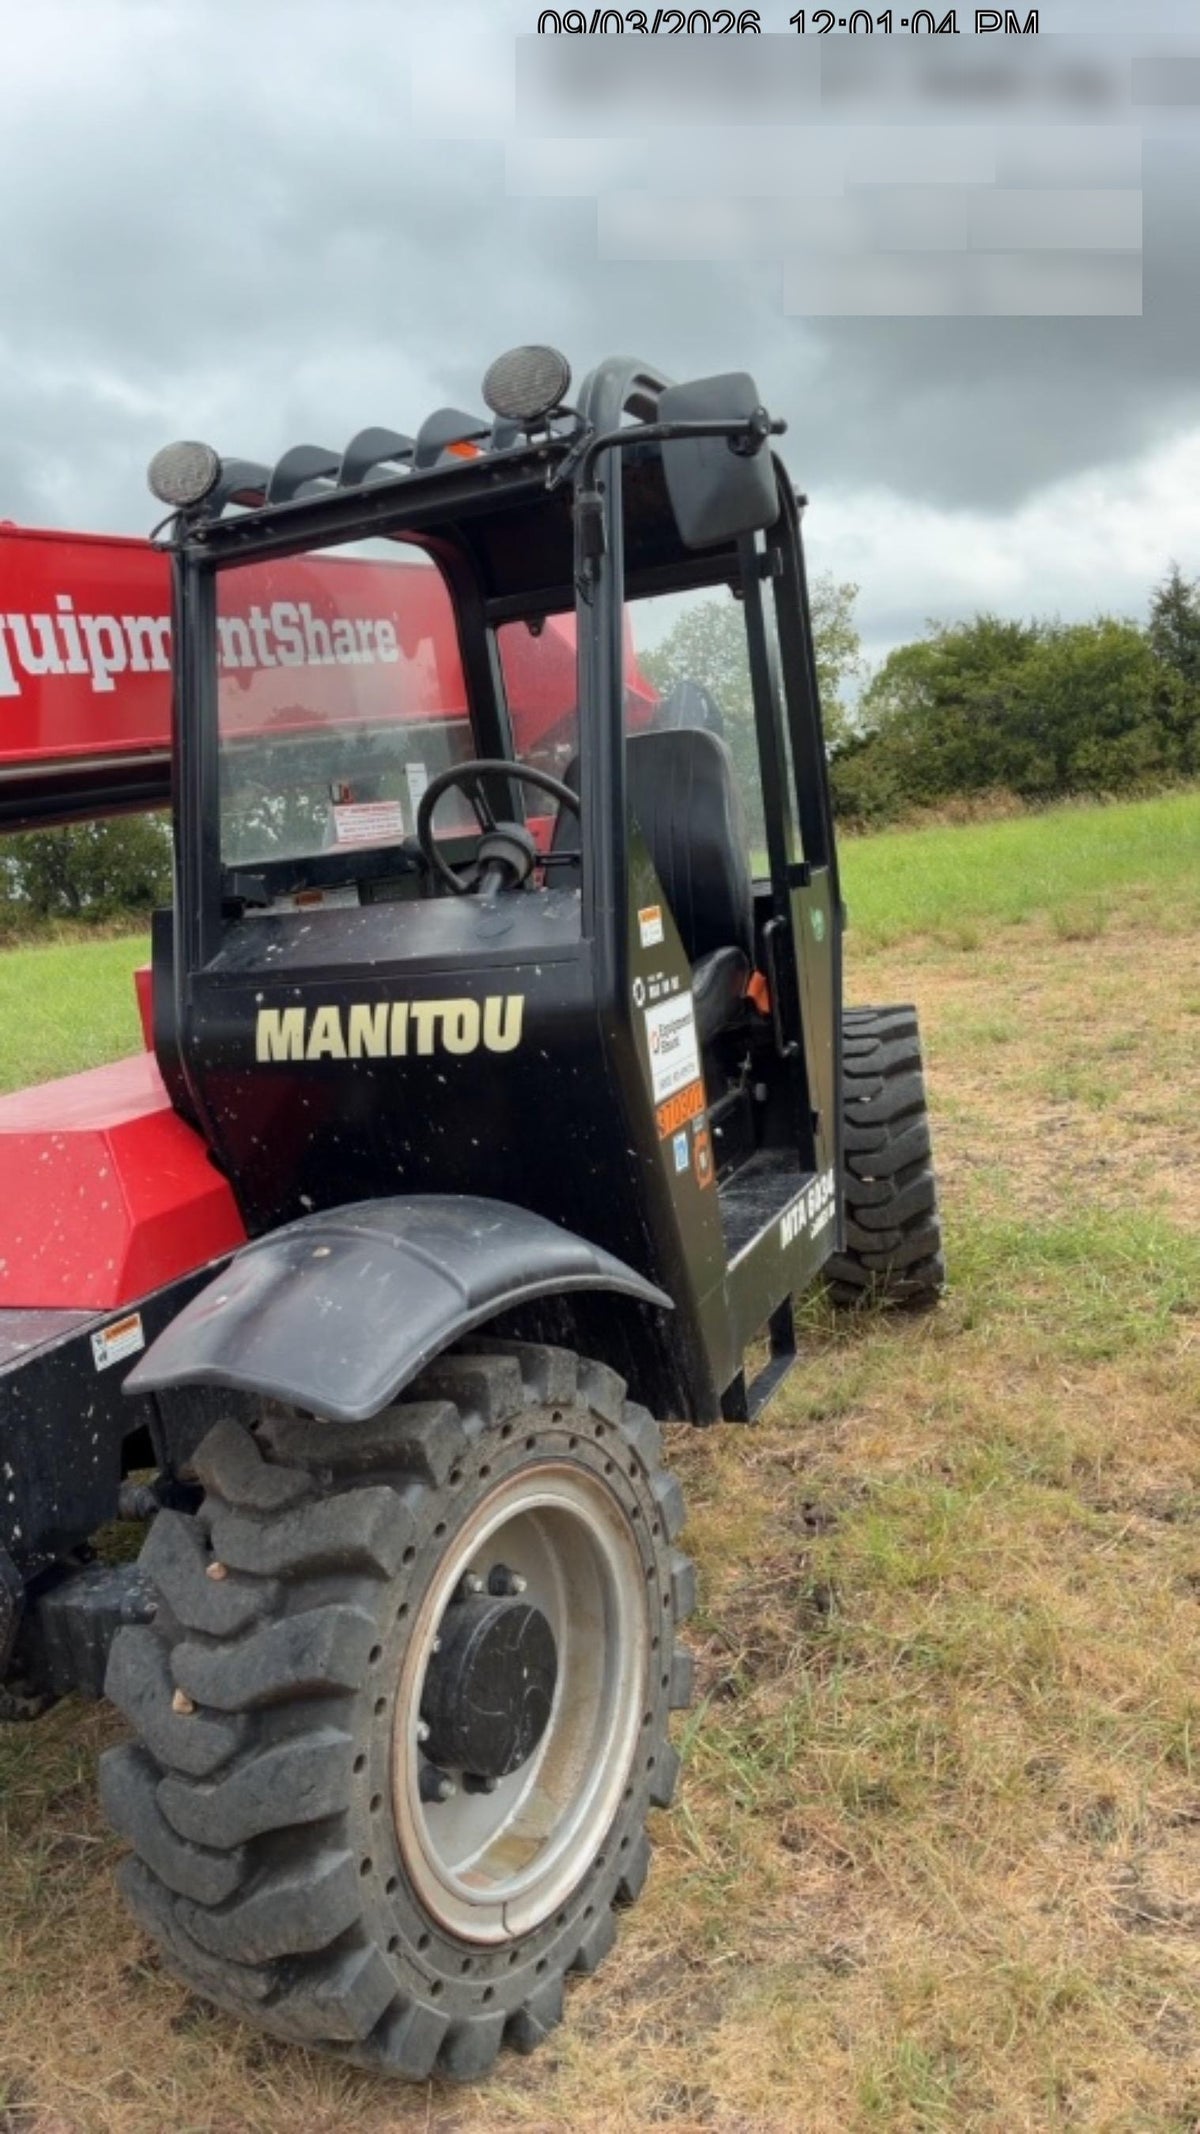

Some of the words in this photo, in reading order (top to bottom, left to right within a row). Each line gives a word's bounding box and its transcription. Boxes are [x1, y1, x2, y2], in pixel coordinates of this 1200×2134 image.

[0, 594, 400, 695] uipmntShare
[256, 995, 524, 1063] MANITOU
[780, 1196, 807, 1250] MTA
